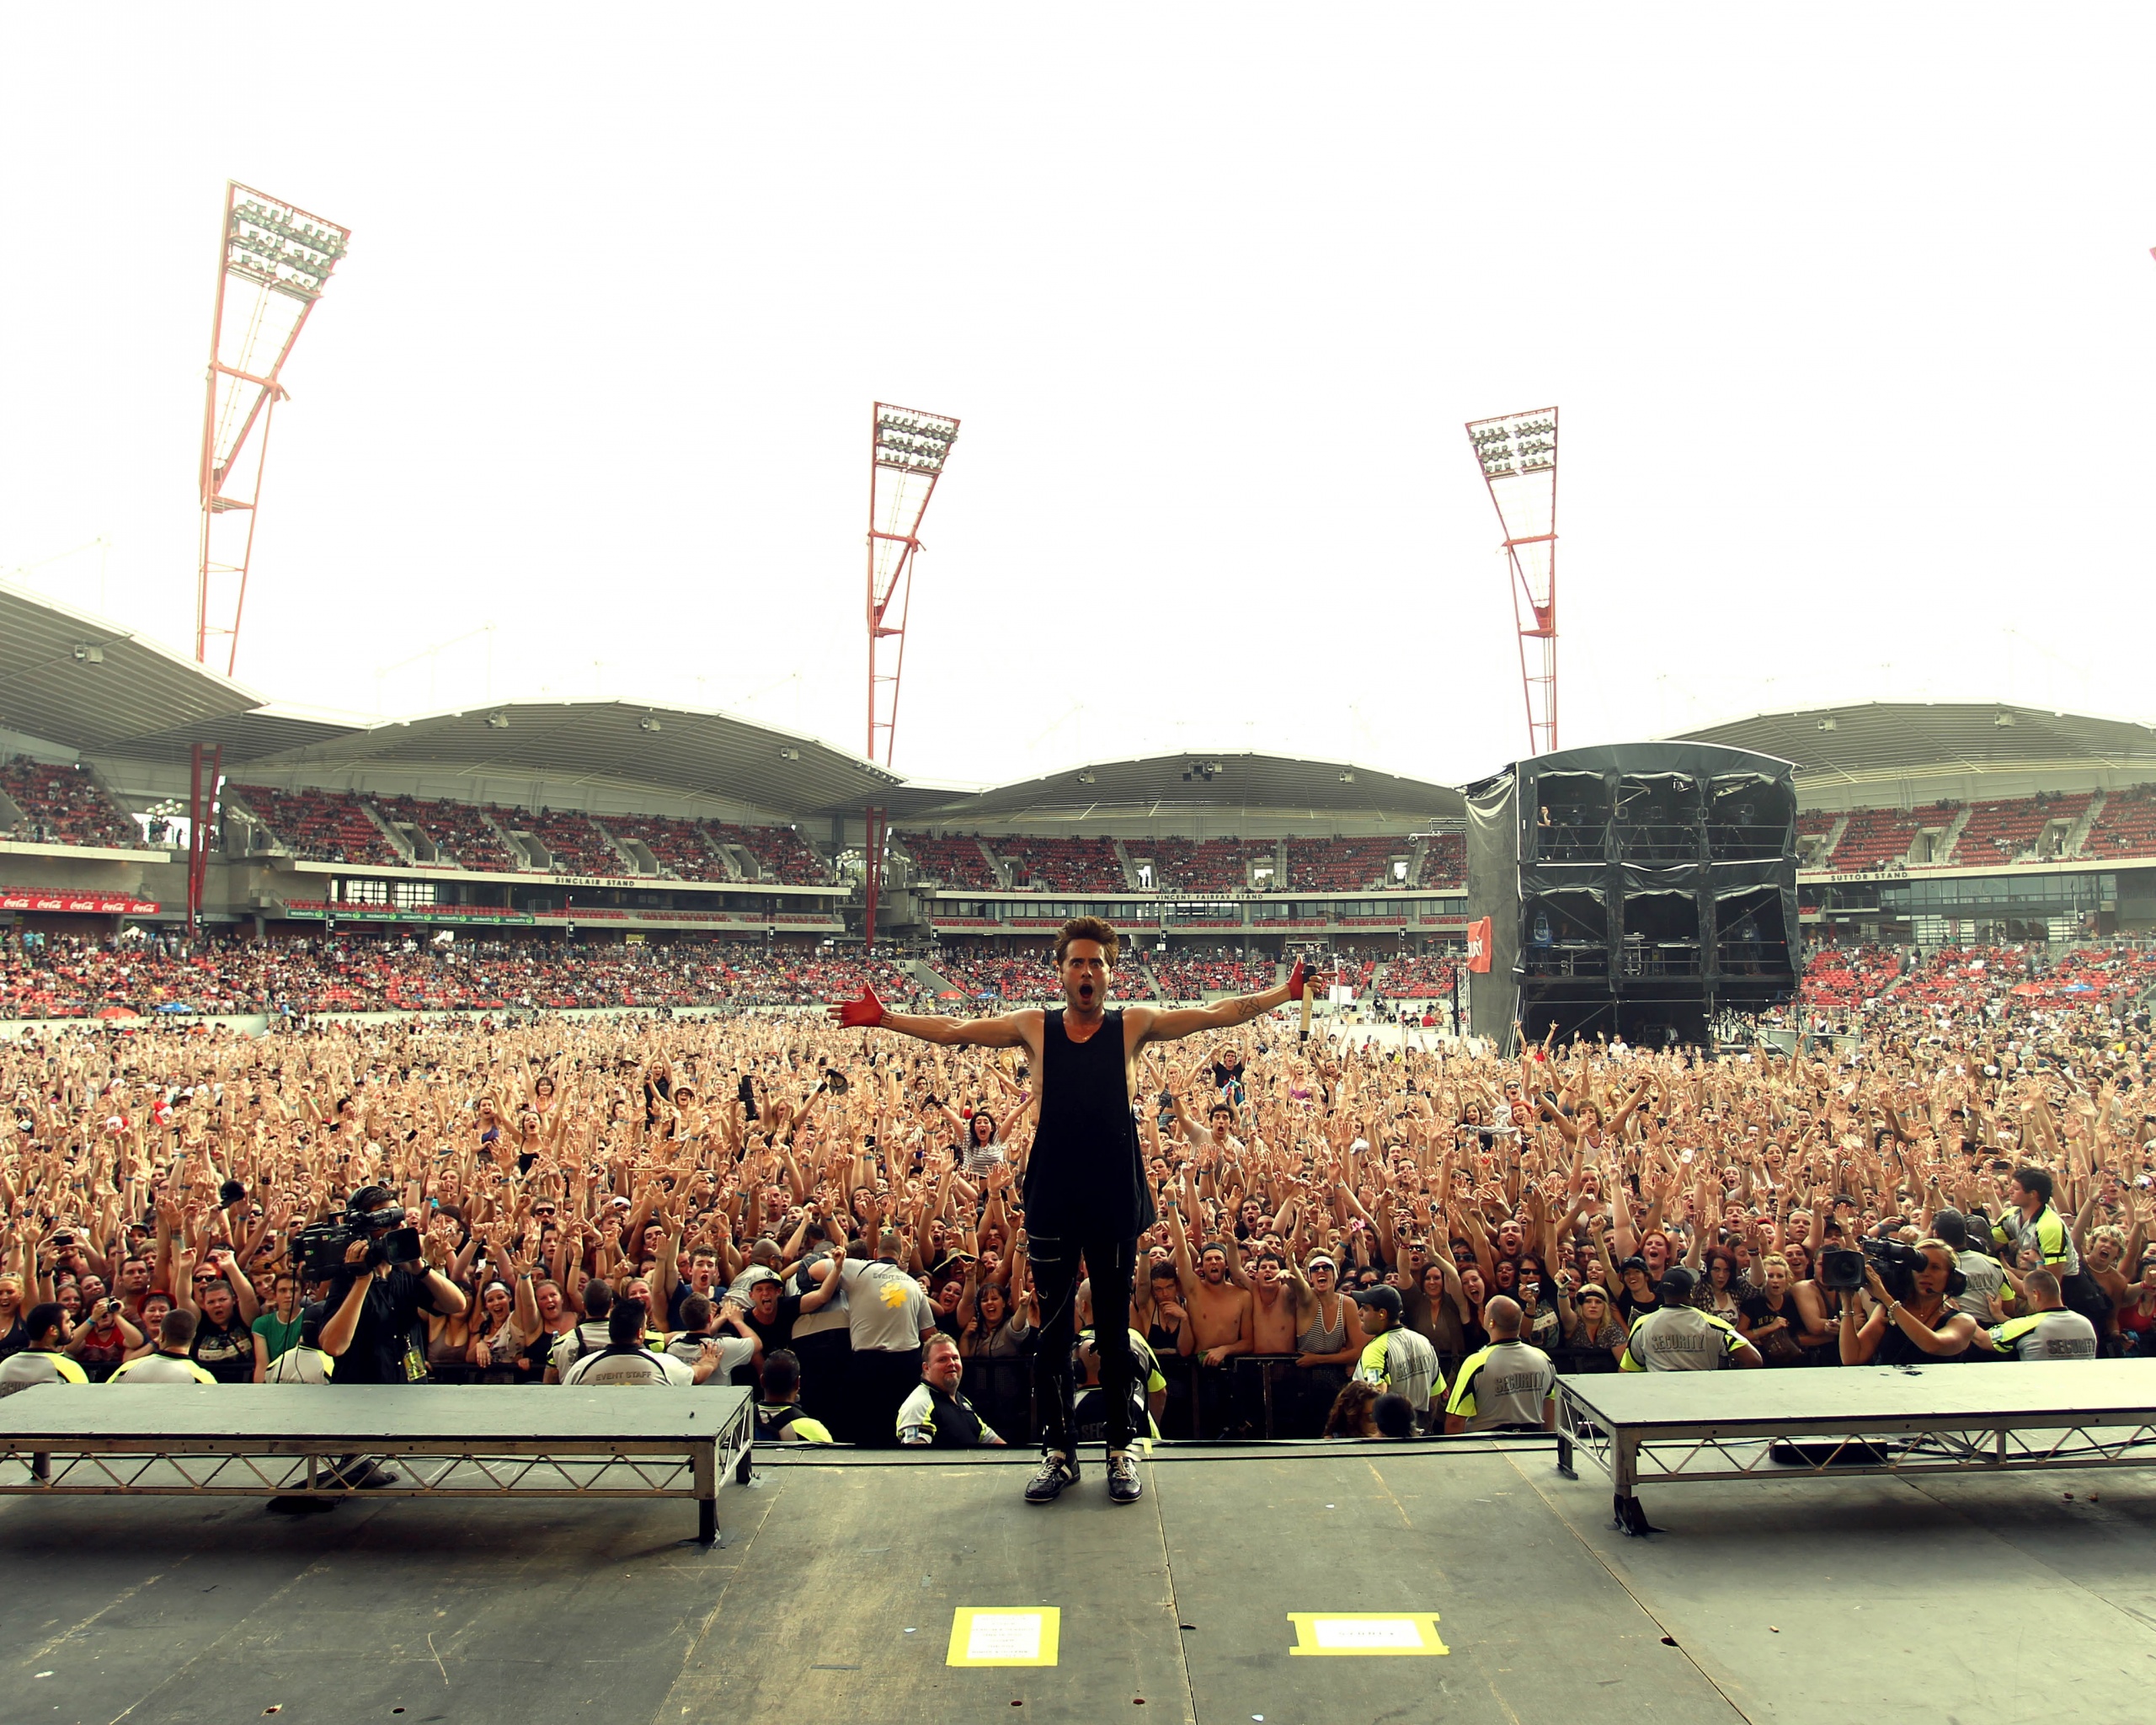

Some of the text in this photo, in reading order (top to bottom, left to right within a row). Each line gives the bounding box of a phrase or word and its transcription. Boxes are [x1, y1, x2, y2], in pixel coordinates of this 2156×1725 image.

[555, 877, 600, 885] SINCLAIR
[1652, 1334, 1705, 1350] SECURITY
[595, 1370, 652, 1381] EVENT STAFF
[1495, 1370, 1545, 1393] SECURITY
